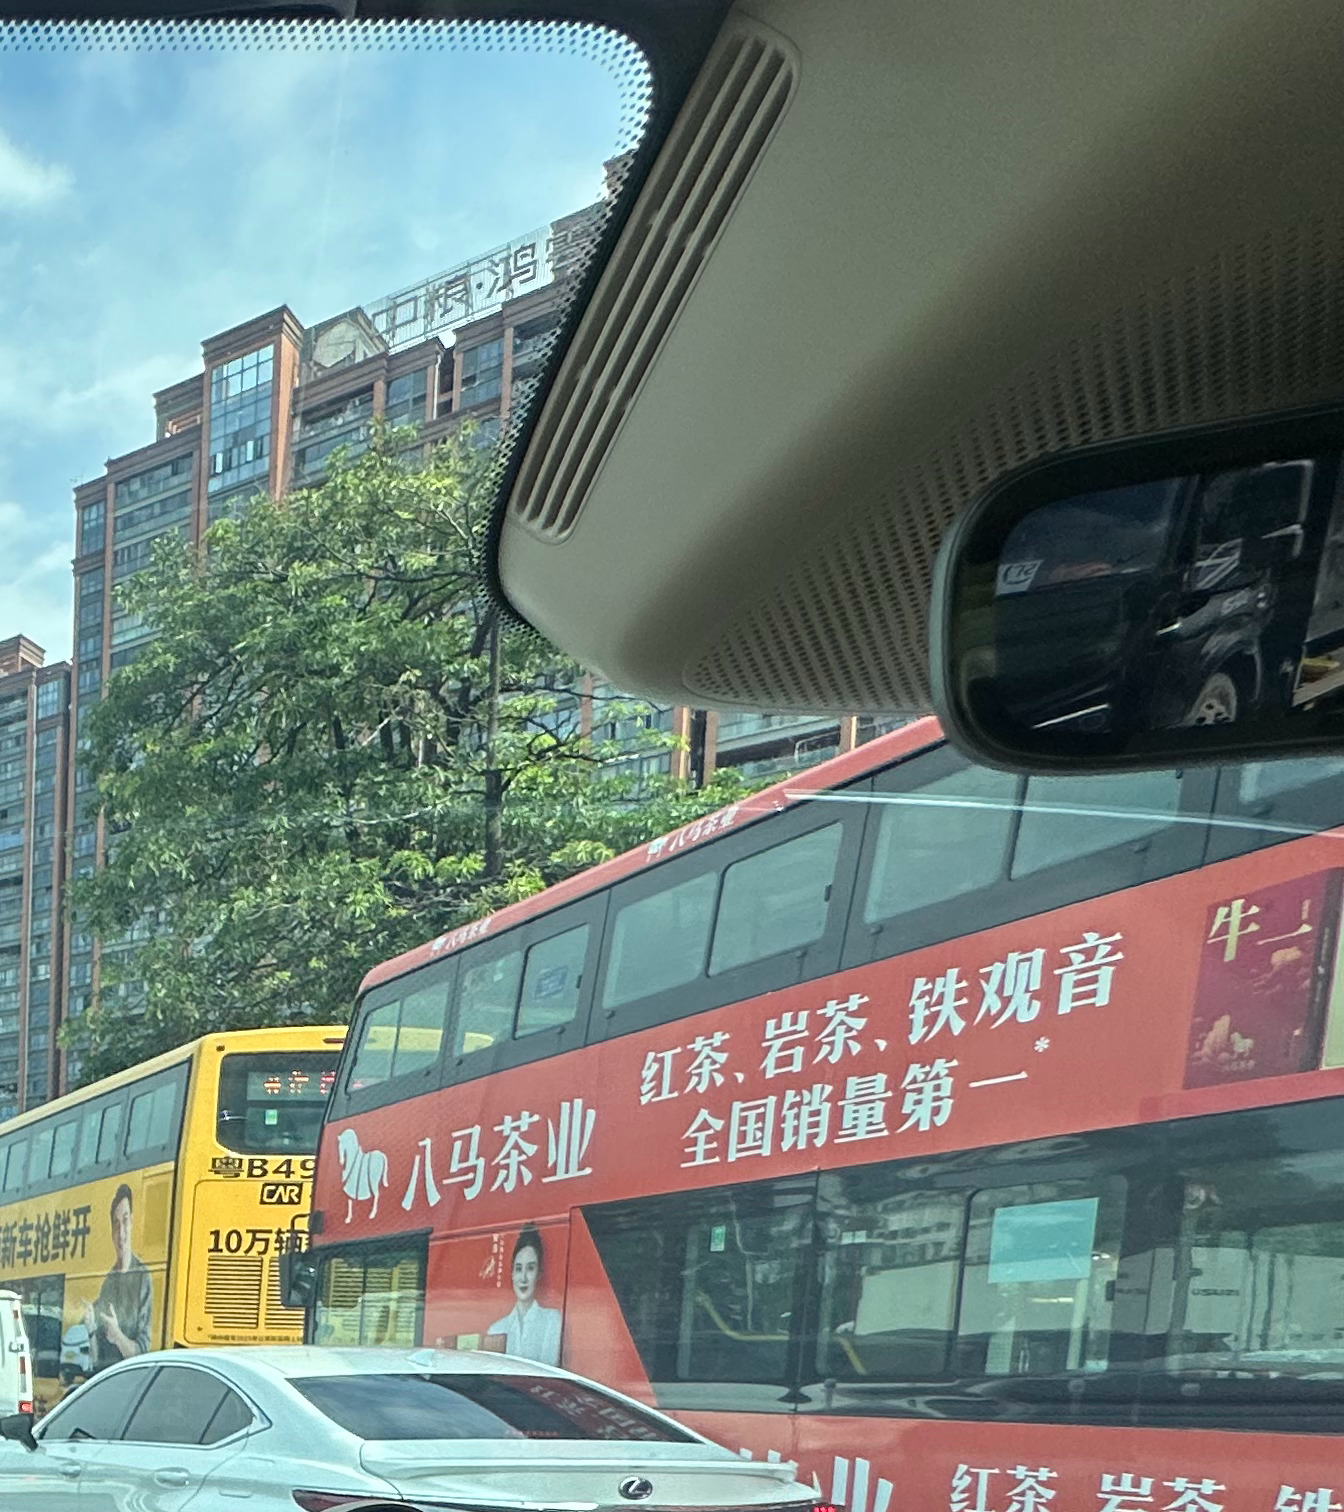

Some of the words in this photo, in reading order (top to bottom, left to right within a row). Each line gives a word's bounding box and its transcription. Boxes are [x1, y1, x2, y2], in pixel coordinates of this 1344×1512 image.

[639, 932, 1124, 1107] 红茶、岩茶、铁观音
[401, 1098, 596, 1211] 八马茶业
[262, 1184, 300, 1204] CAR
[207, 1228, 309, 1257] 10万辆
